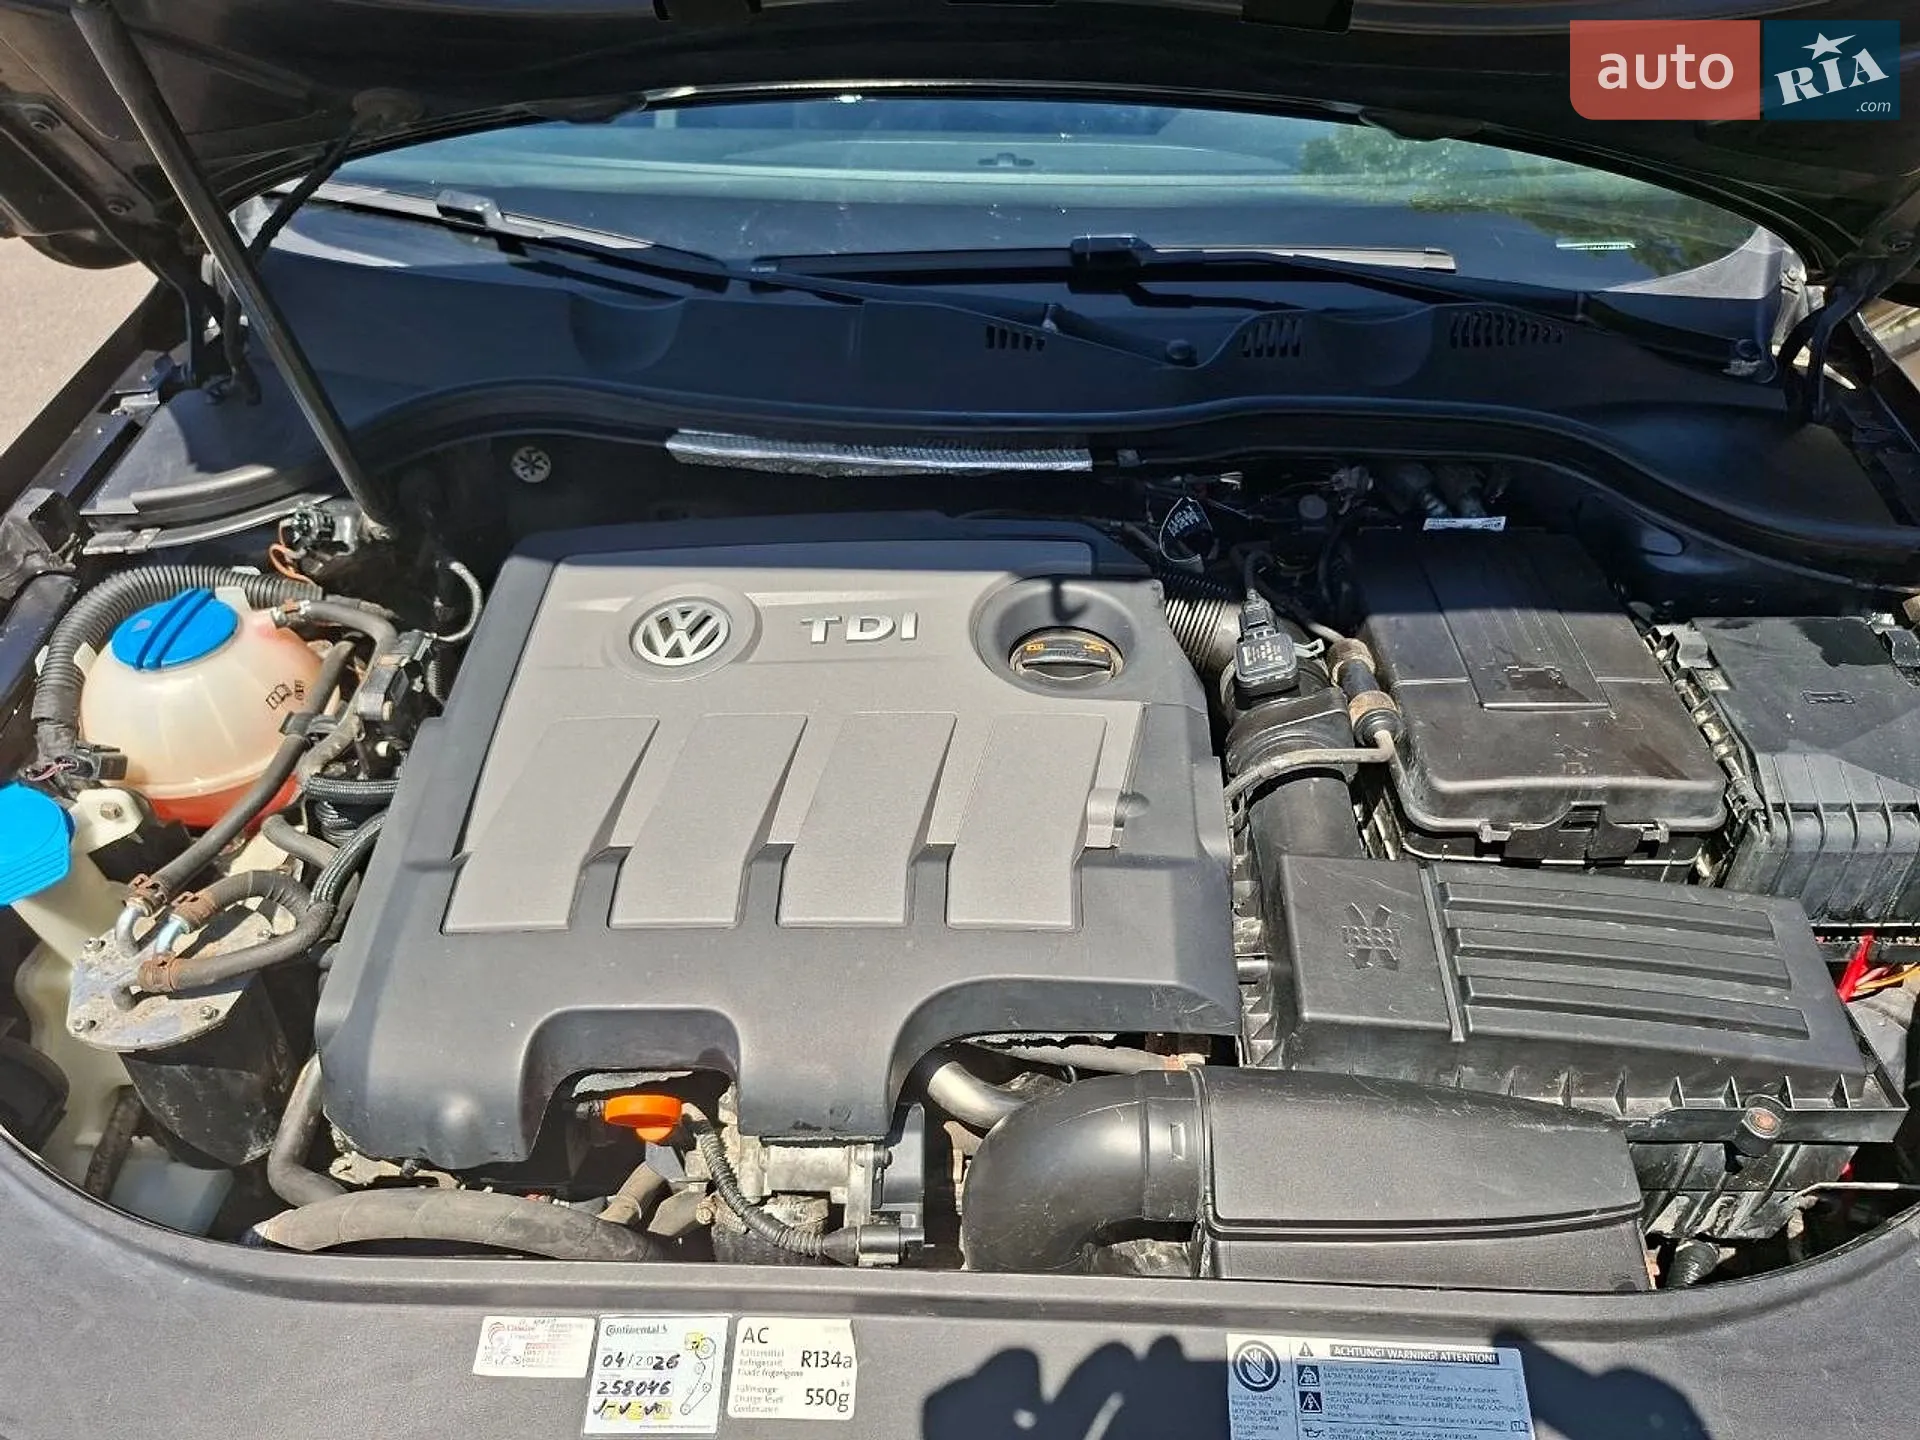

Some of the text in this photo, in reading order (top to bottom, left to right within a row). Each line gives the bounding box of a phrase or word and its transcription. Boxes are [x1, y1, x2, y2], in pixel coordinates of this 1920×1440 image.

[634, 601, 730, 666] VW
[801, 611, 919, 643] TDI
[741, 1327, 769, 1344] AC
[801, 1350, 852, 1369] R134a
[1387, 1349, 1438, 1362] WARNING!
[1440, 1351, 1497, 1364] ATTENTION!
[597, 1380, 671, 1396] 258046
[805, 1388, 850, 1413] 550g
